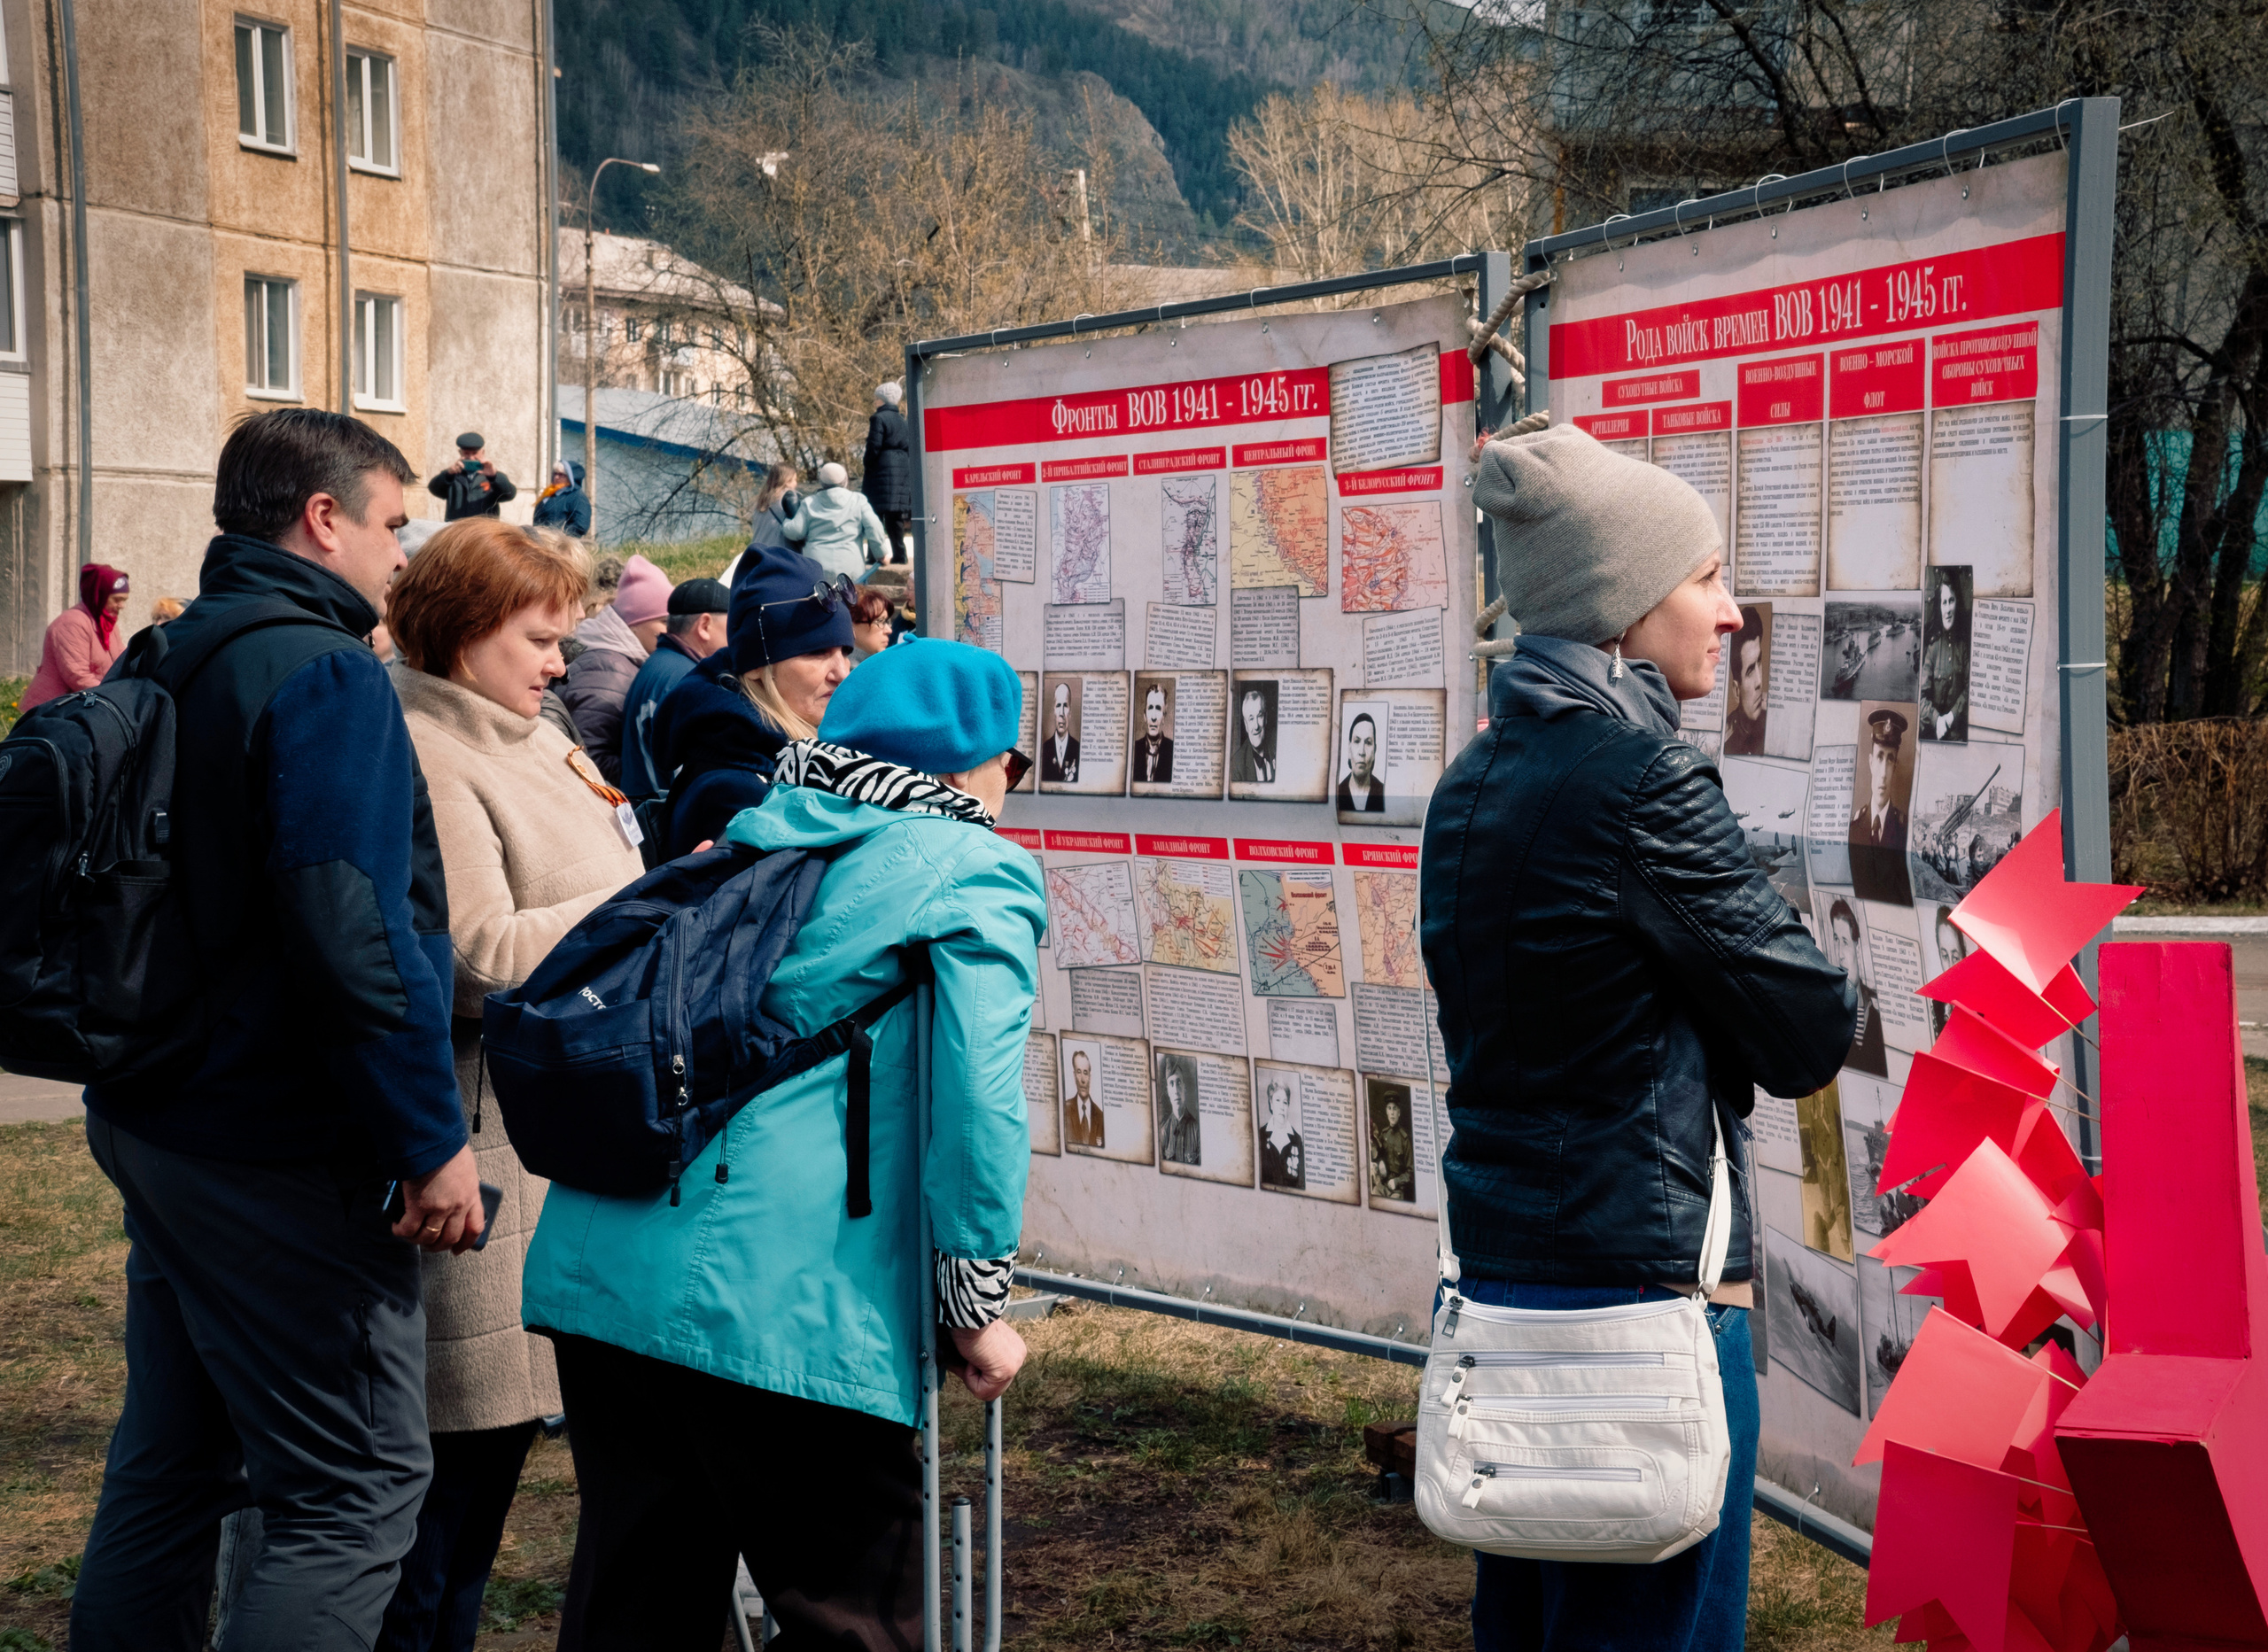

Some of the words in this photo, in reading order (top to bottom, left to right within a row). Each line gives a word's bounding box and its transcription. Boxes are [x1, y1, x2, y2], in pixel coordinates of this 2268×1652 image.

[1774, 289, 1814, 341] ВОВ
[1818, 278, 1863, 334] 1941
[1885, 265, 1937, 322] 1945
[1942, 275, 1967, 314] гг.
[1840, 353, 1868, 372] ВОЕННО
[1876, 344, 1914, 368] МОРСКОЙ
[1932, 340, 1959, 360] ВОЙСКА
[1745, 361, 1816, 384] ВОЕННО-ВОЗДУШНЫЕ
[1942, 361, 1975, 379] ОБОРОНЫ
[1618, 380, 1658, 399] СУХОПУТНЫЕ
[1659, 376, 1683, 394] ВОЙСКА
[1970, 377, 1993, 397] ВОЙСК
[1127, 390, 1167, 428] ВОВ
[1172, 384, 1220, 423] 1941
[1239, 376, 1289, 416] 1945
[1293, 384, 1318, 411] гг.
[1863, 391, 1885, 408] ФЛОТ
[1662, 411, 1695, 429] ТАНКОВЫЕ
[1696, 407, 1721, 425] ВОЙСКА
[1770, 402, 1790, 418] СИЛЫ
[1591, 418, 1629, 434] АРТИЛЛЕРИЯ
[1138, 454, 1196, 470] СТАЛИНГРАДСКИЙ
[1197, 453, 1220, 466] ФРОНТ
[1244, 445, 1294, 461] ЦЕНТРАЛЬНЫЙ
[1295, 445, 1317, 457] ФРОНТ
[964, 469, 1001, 484] КАРЕЛЬСКИЙ
[1002, 469, 1022, 482] ФРОНТ
[1053, 461, 1106, 477] ПРИБАЛТИЙСКИЙ
[1107, 461, 1127, 473] ФРОНТ
[1345, 477, 1357, 491] 3-Й
[1358, 473, 1406, 491] БЕЛОРУССКИЙ
[1407, 473, 1436, 486] ФРОНТ
[1051, 835, 1061, 847] 1-Й
[1061, 835, 1101, 849] УКРАИНСКИЙ
[1102, 837, 1123, 849] ФРОНТ
[1153, 840, 1187, 852] ЗАПАДНЫЙ
[1188, 842, 1210, 854] ФРОНТ
[1249, 844, 1293, 858] ВОЛХОВСКИЙ
[1294, 847, 1318, 859] ФРОНТ
[1363, 849, 1402, 863] БРЯНСКИЙ
[1402, 851, 1418, 864] ФРО
